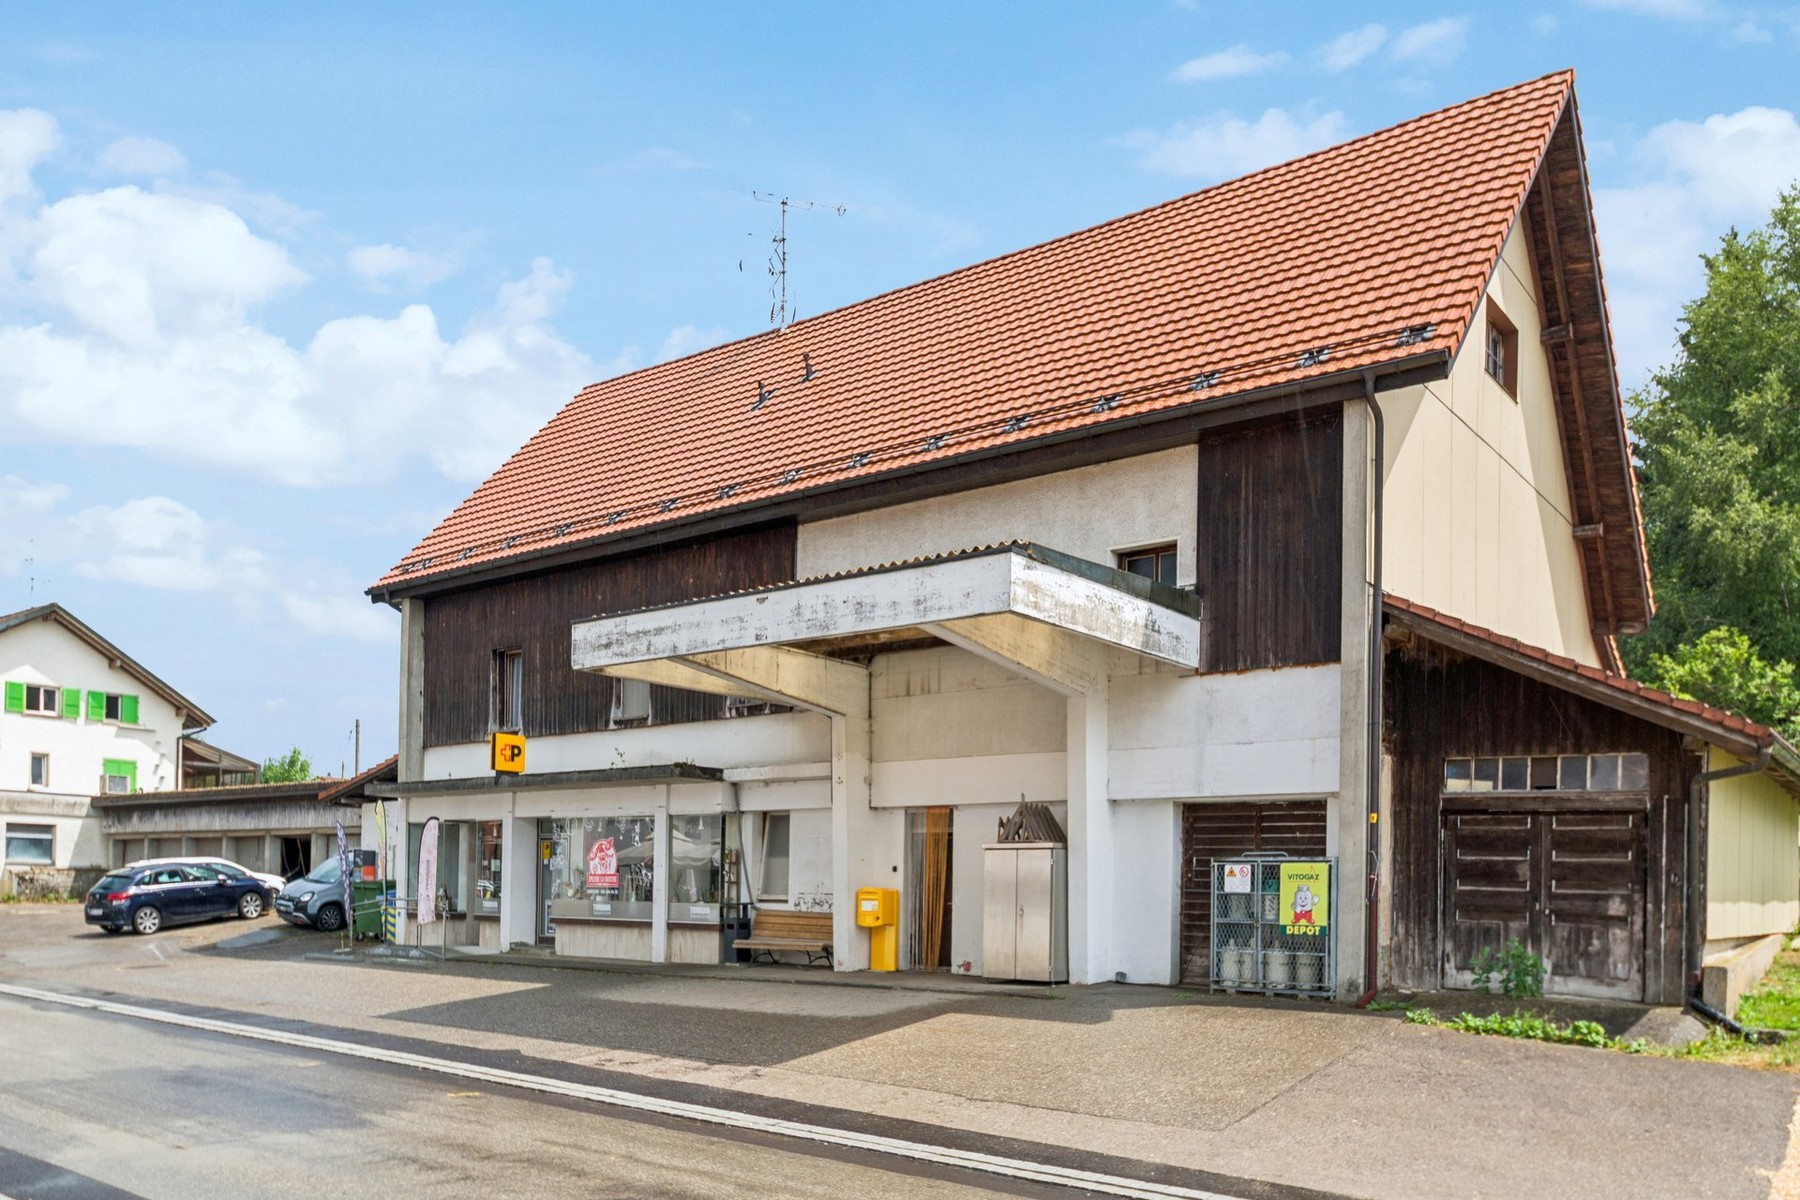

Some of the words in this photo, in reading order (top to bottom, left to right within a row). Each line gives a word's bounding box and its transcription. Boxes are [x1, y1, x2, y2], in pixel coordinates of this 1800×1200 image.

[510, 744, 522, 762] P
[1287, 873, 1320, 881] VITOGAZ
[1286, 925, 1321, 936] DEPOT
